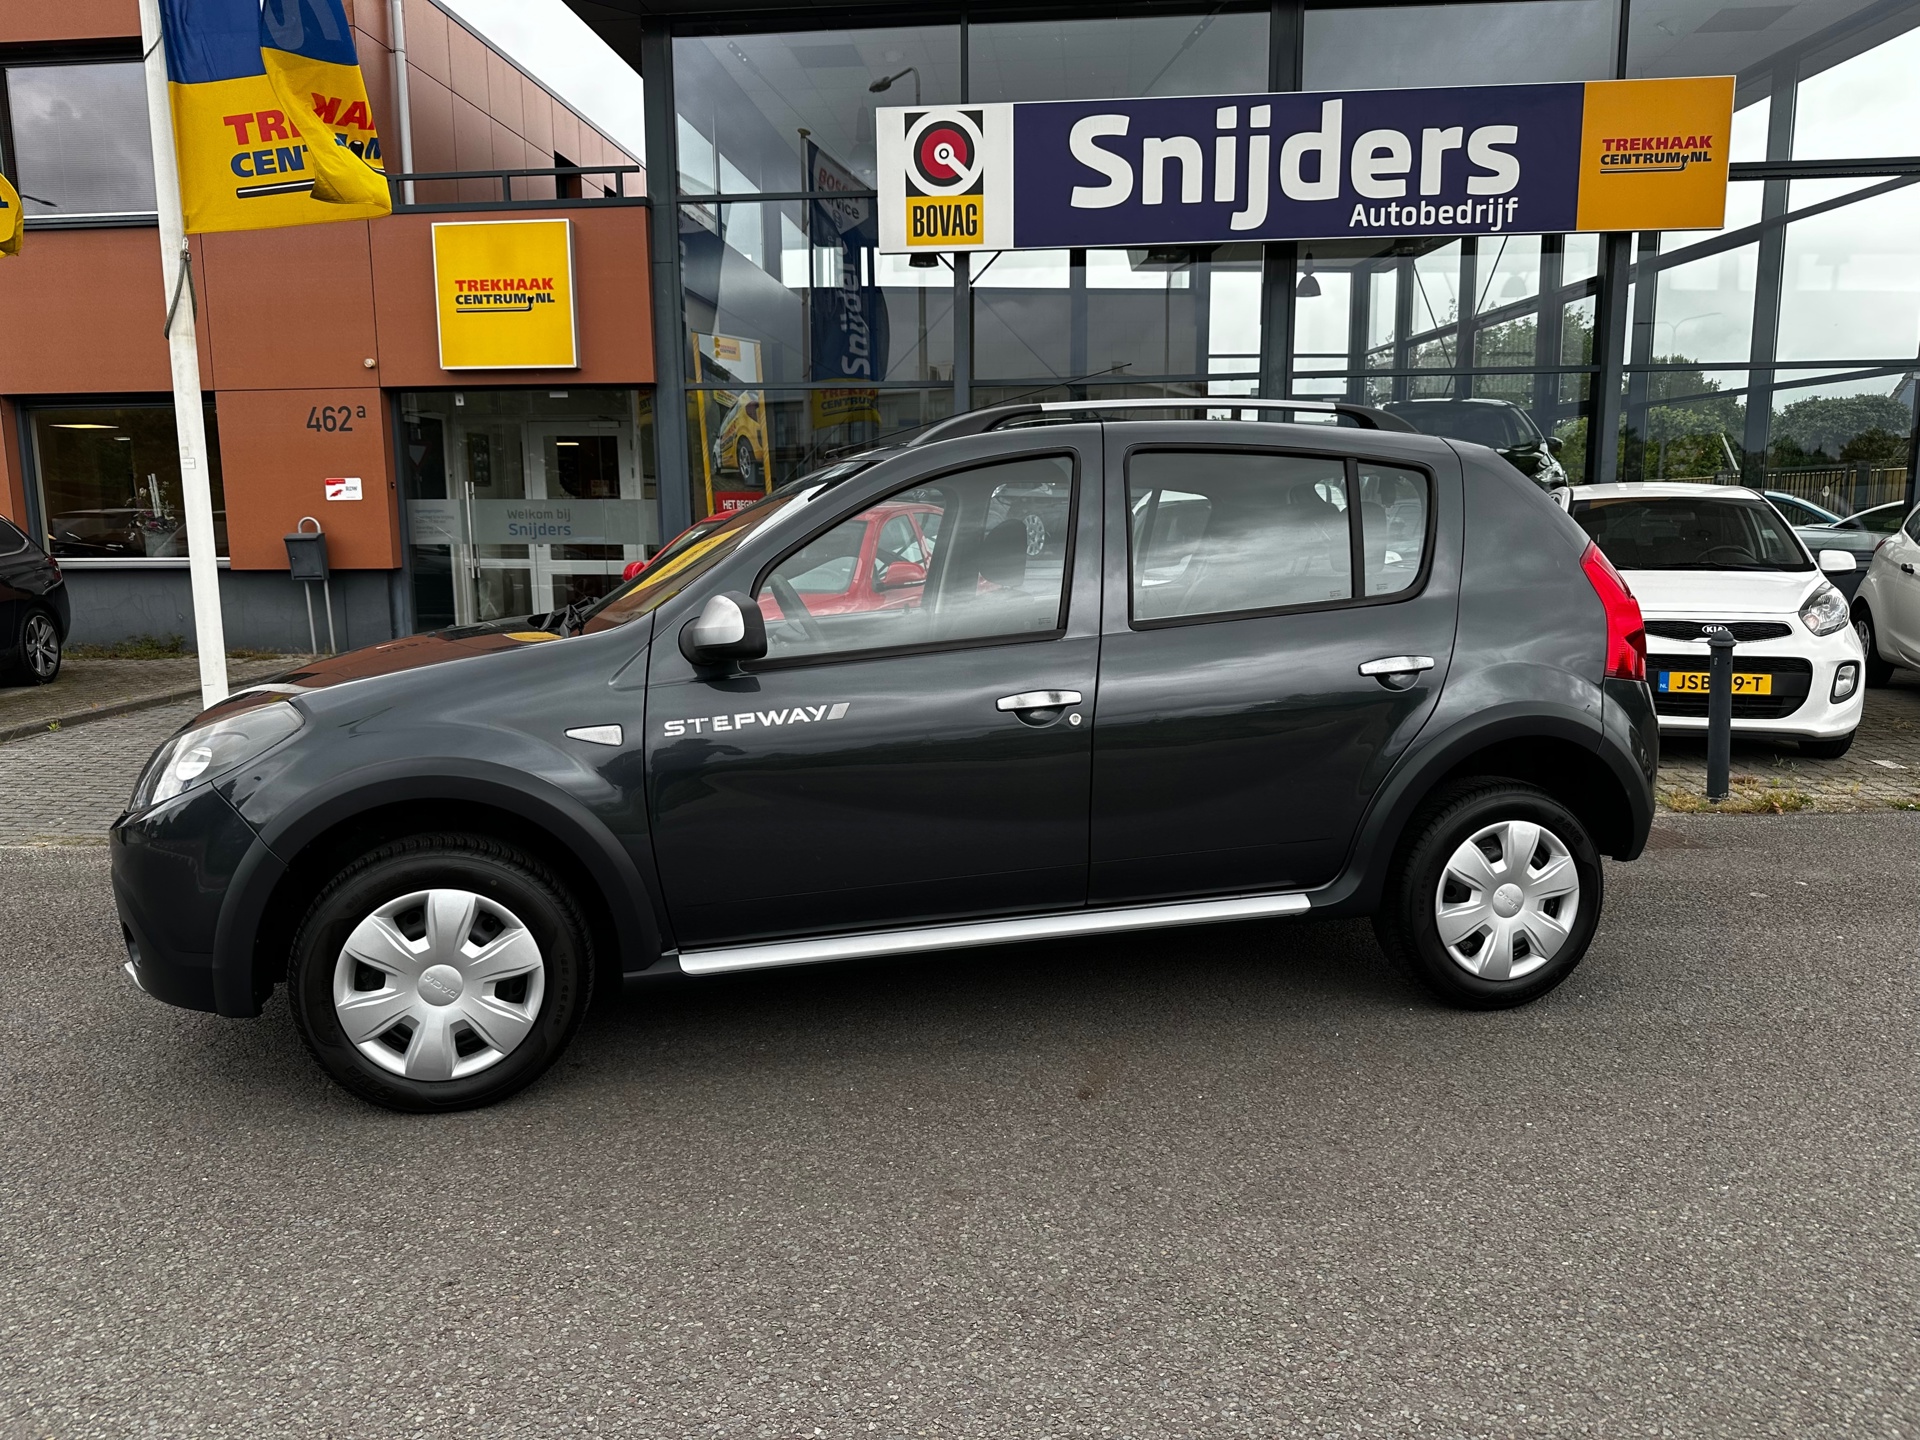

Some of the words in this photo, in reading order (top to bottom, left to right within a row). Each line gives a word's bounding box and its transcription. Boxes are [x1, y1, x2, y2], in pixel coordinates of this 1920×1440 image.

[1602, 135, 1713, 152] TREKHAAK
[230, 144, 309, 178] CEN
[1068, 98, 1521, 231] Snijders
[912, 203, 978, 238] BOVAG
[1349, 197, 1519, 232] Autobedrijf
[455, 277, 554, 292] TREKHAAK
[507, 508, 554, 520] Welkom
[556, 508, 571, 523] bij
[722, 499, 736, 510] HET
[508, 522, 572, 540] Snijders
[663, 704, 828, 737] STEPWAY
[424, 972, 459, 1000] DACIA
